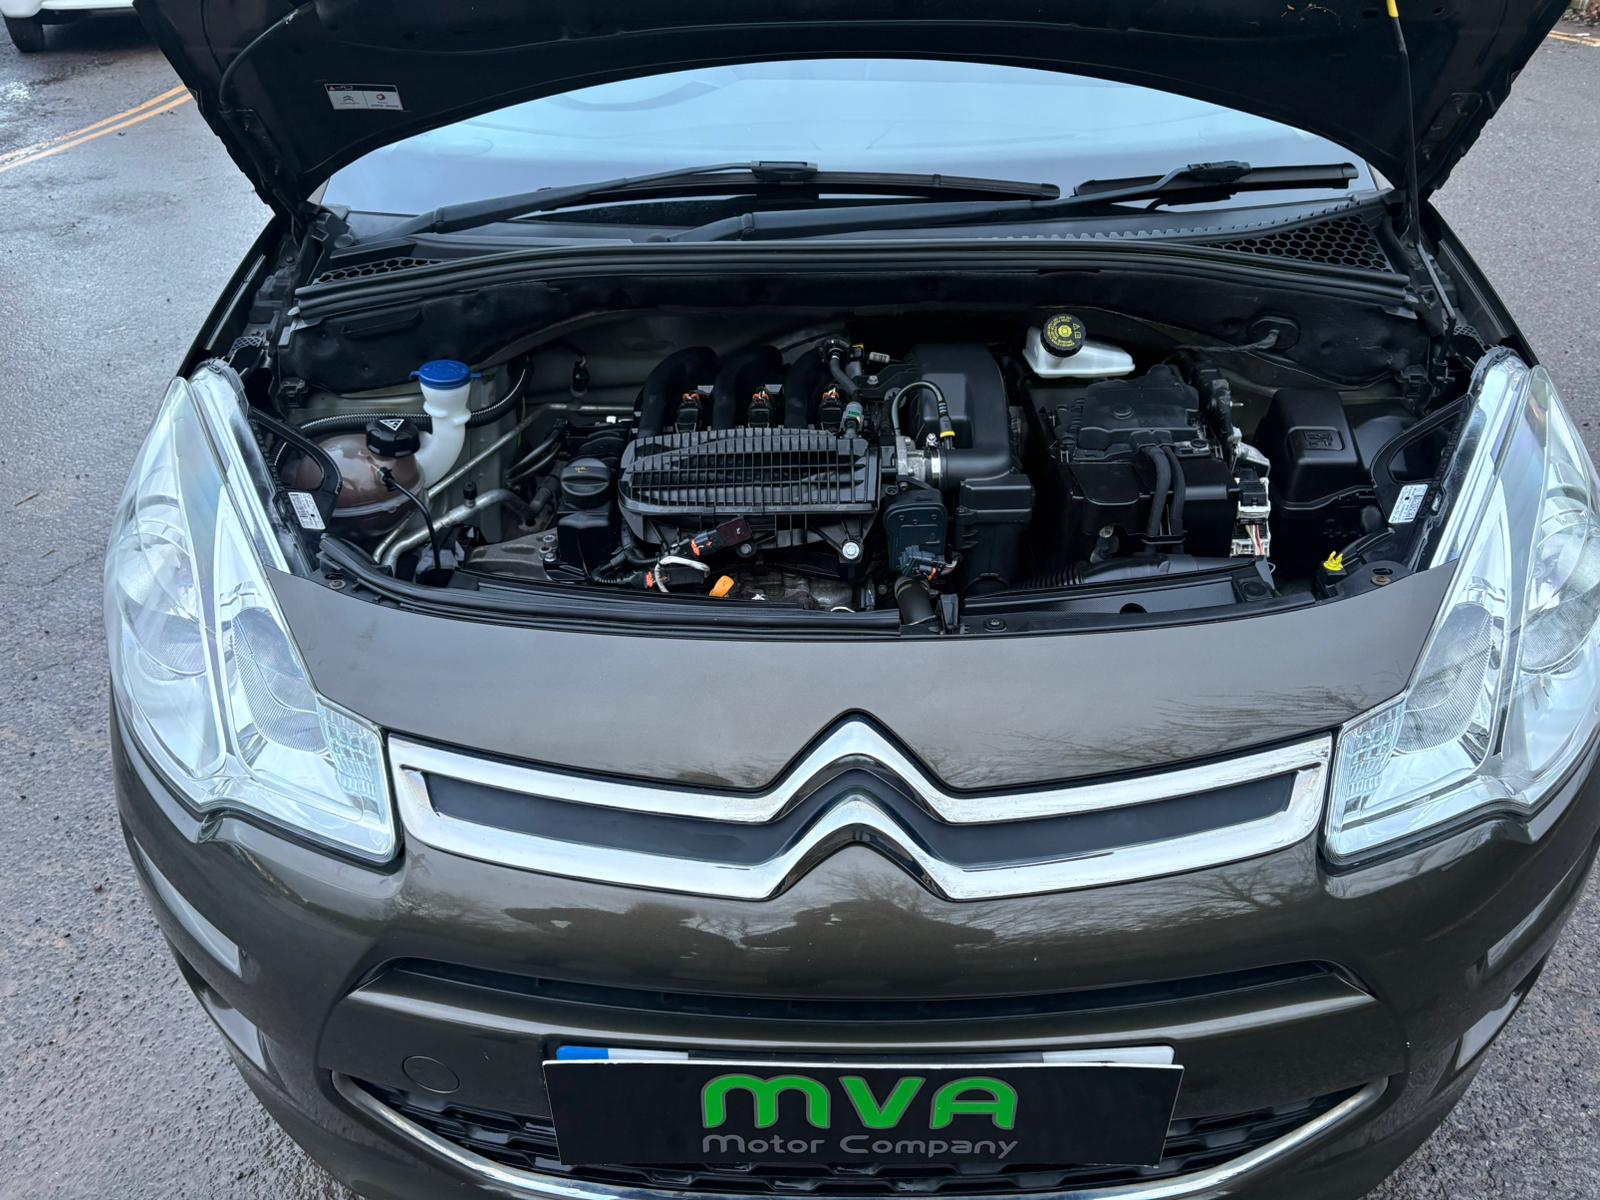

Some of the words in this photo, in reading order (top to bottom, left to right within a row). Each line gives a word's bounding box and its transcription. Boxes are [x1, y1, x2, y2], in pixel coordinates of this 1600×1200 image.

[701, 1073, 1018, 1130] MVA
[702, 1134, 825, 1154] Motor
[839, 1135, 1018, 1159] Company
